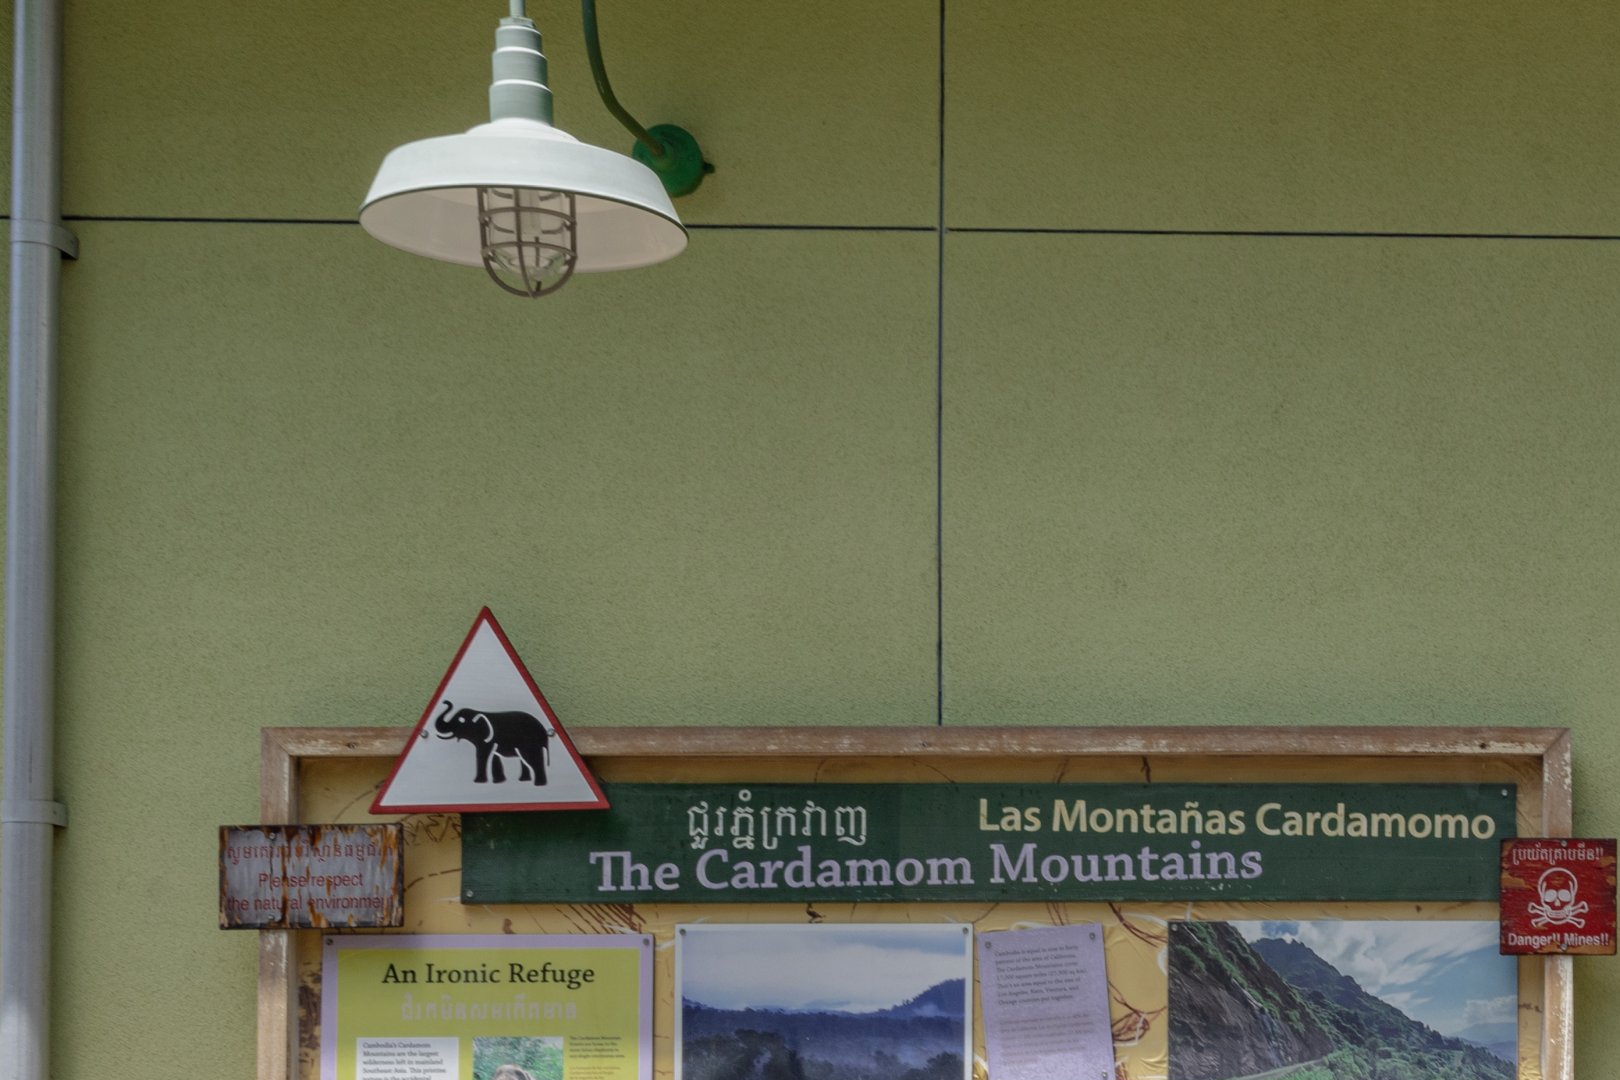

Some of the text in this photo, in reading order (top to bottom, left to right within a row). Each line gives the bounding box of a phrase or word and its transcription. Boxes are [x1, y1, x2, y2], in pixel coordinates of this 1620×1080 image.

[978, 797, 1496, 840] Las Montañas Cardamomo
[589, 841, 1263, 892] The Cardamom Mountains
[259, 873, 364, 890] Plese respect
[227, 896, 249, 911] the
[254, 896, 302, 911] natual
[1508, 933, 1609, 949] Danger!! Mines!!
[381, 962, 596, 990] An Ironic Refuge
